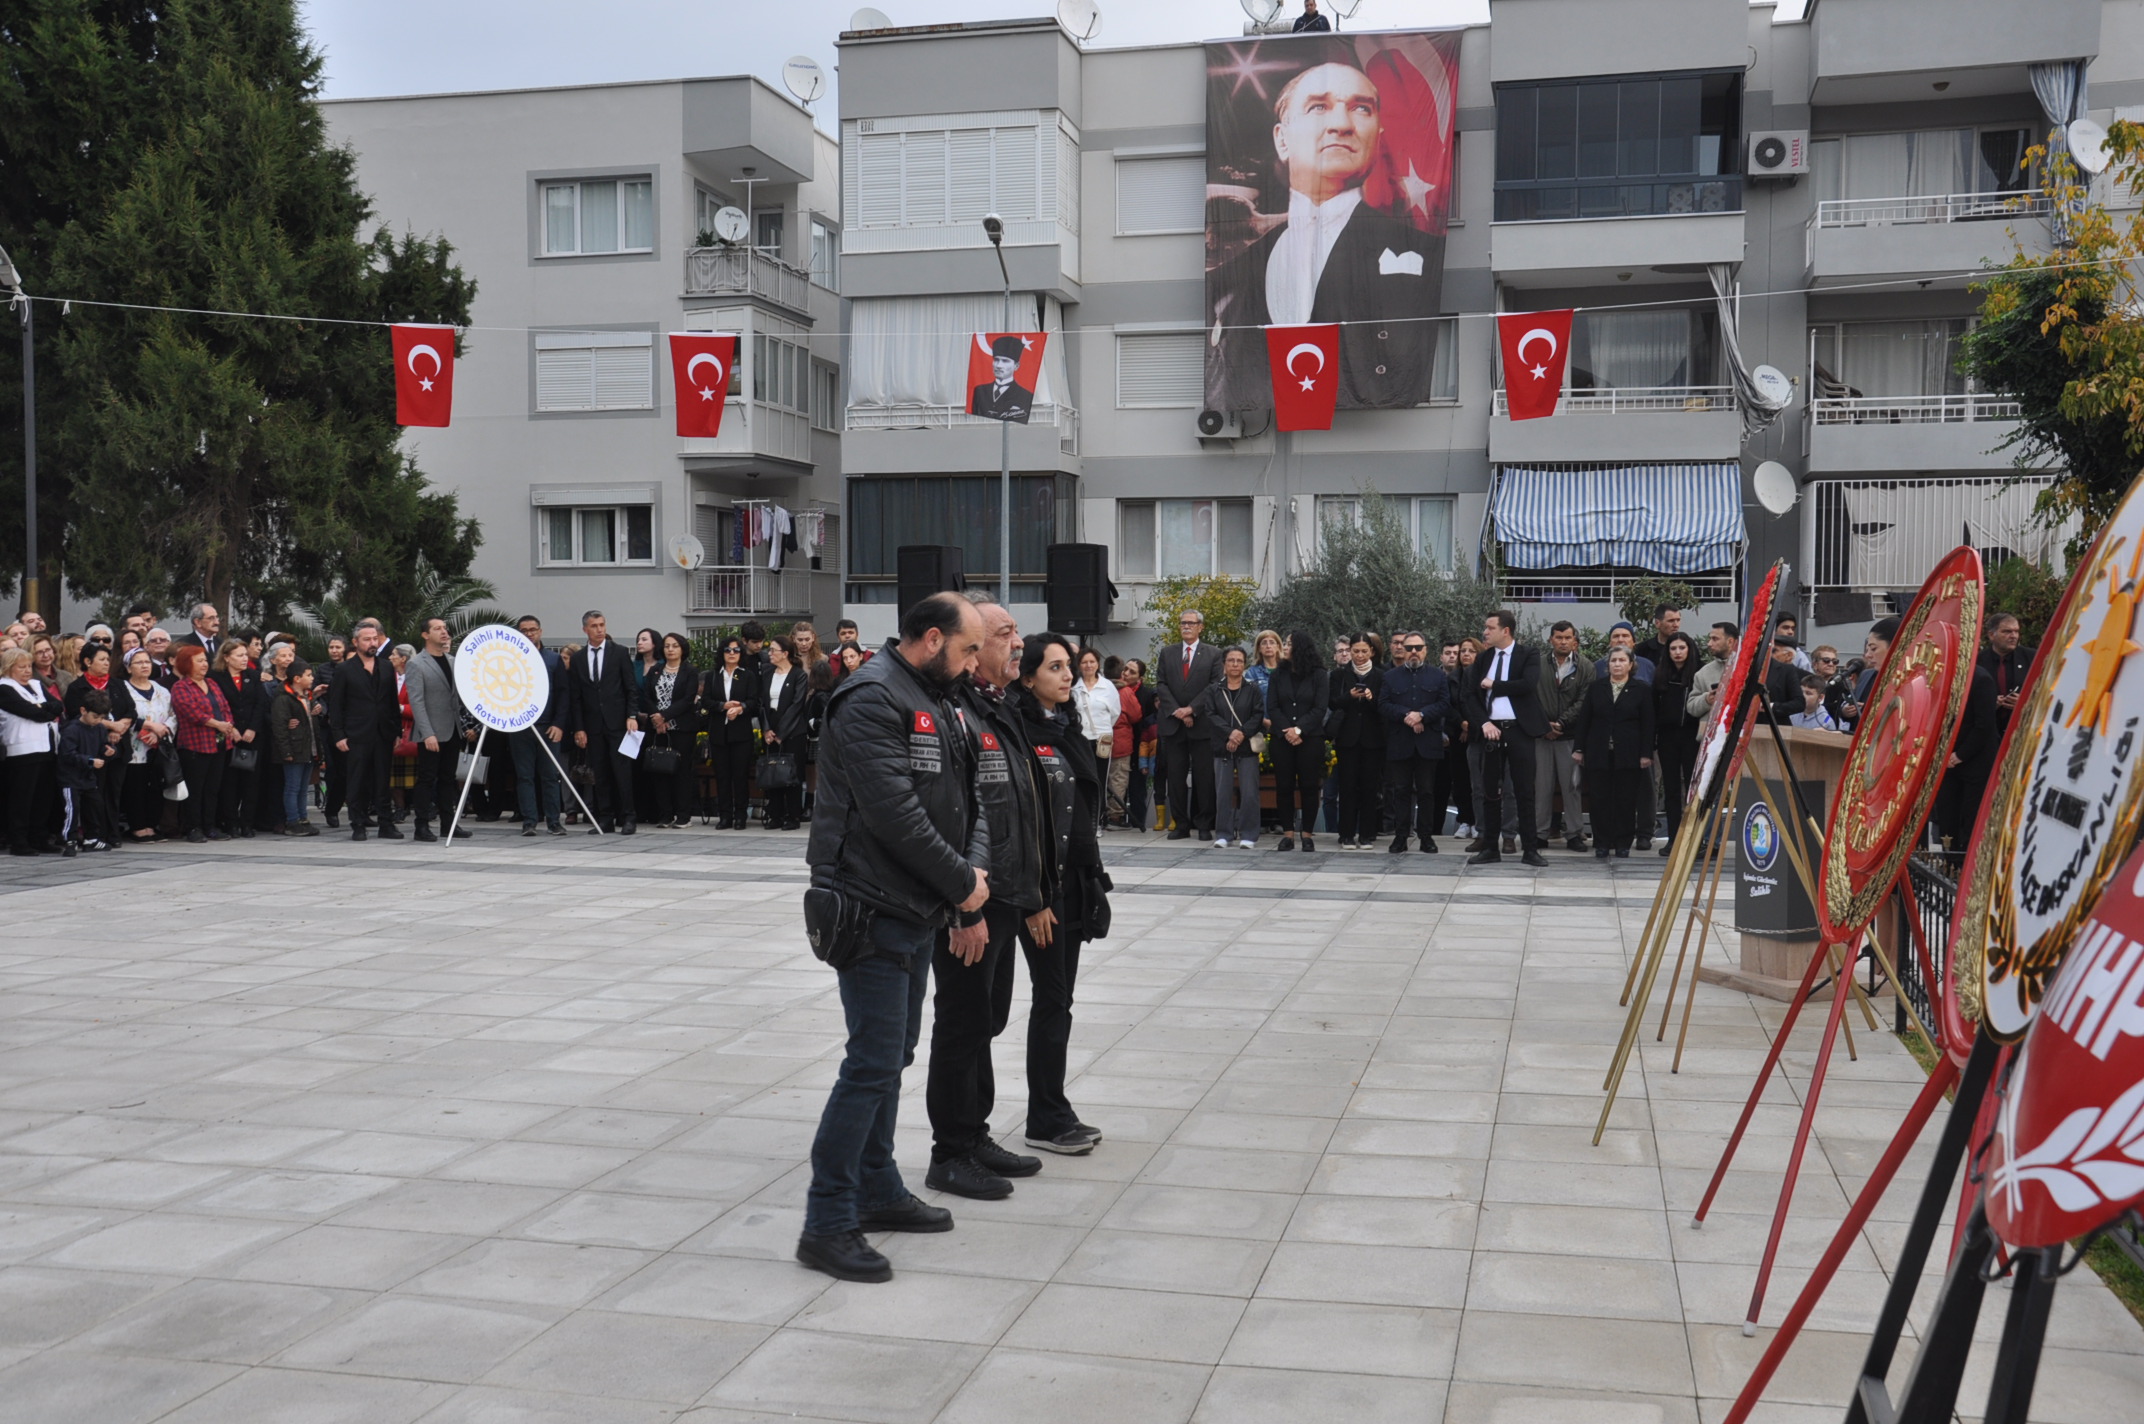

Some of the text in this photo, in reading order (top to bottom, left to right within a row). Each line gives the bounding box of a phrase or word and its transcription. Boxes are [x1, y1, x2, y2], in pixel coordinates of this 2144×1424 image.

[1791, 137, 1800, 168] VESTEL
[465, 630, 530, 655] Salihli Manisa
[474, 703, 539, 729] Rotary Kulübü
